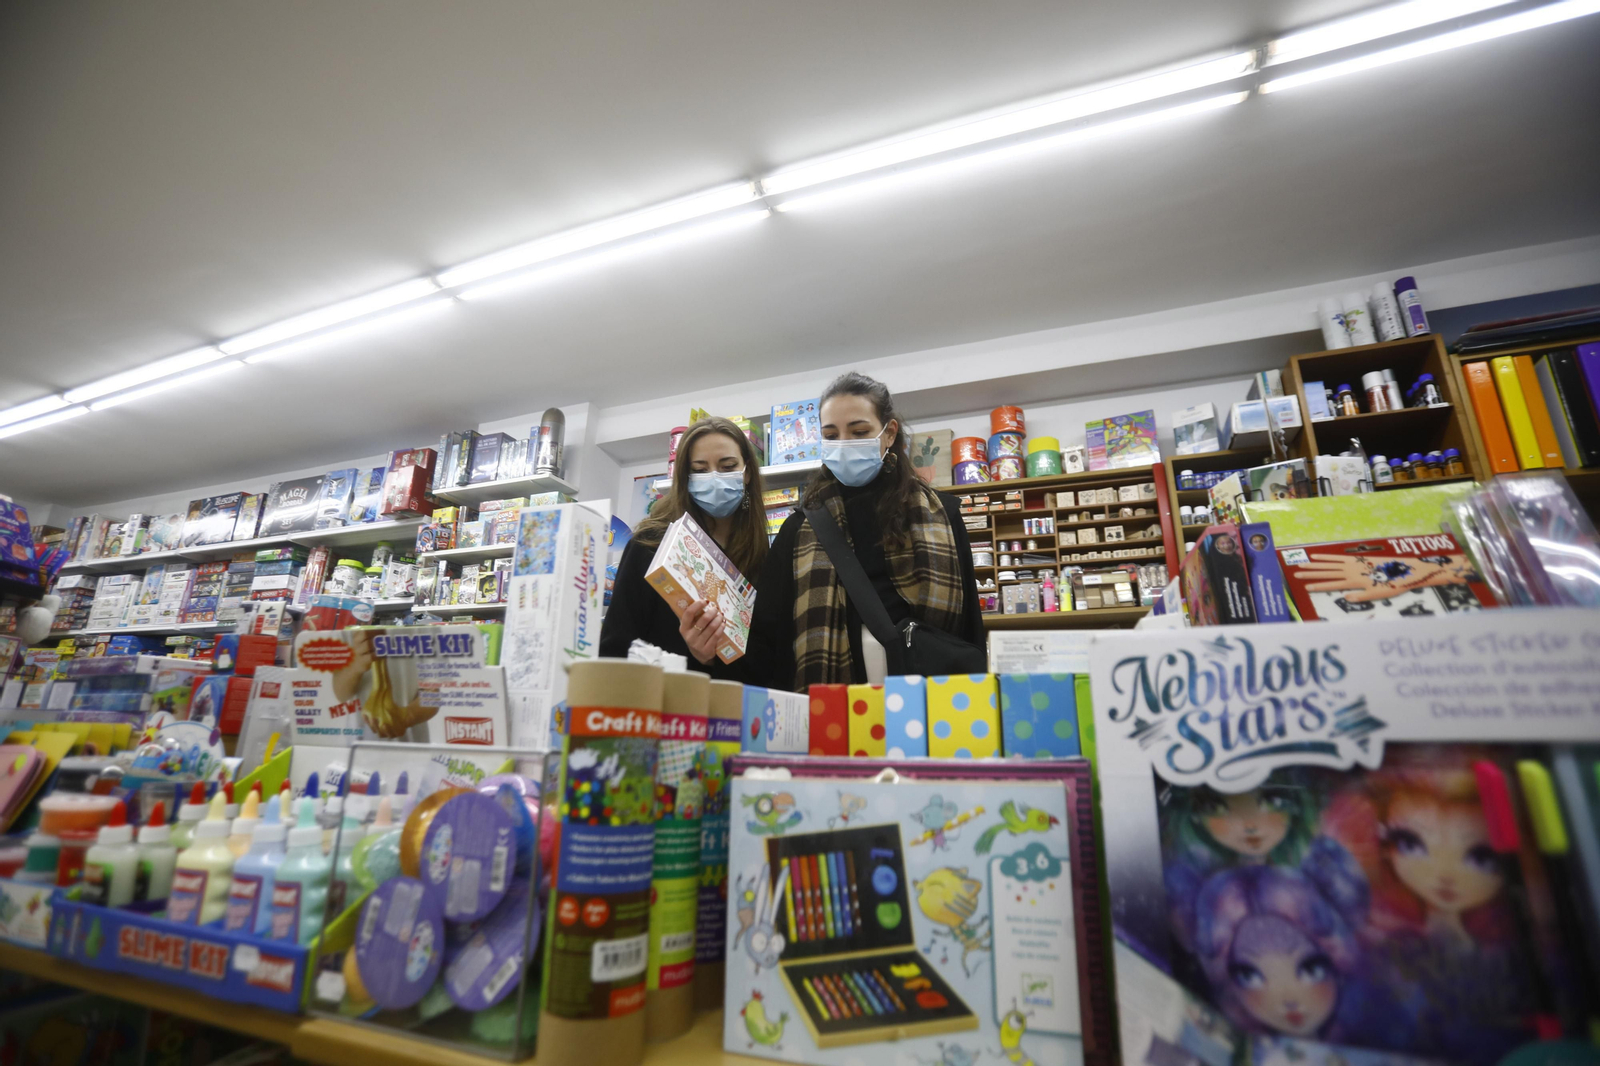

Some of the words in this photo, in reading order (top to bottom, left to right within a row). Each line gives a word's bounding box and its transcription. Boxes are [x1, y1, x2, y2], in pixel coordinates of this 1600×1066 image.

[279, 488, 309, 503] MAGIA
[1388, 535, 1454, 554] TATTOOS
[564, 546, 592, 658] Aquarellum
[374, 635, 432, 656] SLIME
[437, 634, 473, 656] KIT
[1109, 636, 1346, 722] Nebulous
[1384, 661, 1486, 678] Collection
[328, 698, 362, 719] NEW!
[1431, 702, 1505, 719] Deluxe
[446, 718, 493, 742] INSTANT
[586, 711, 642, 733] Craft
[1166, 690, 1330, 774] Stars
[119, 926, 184, 968] SLIME
[188, 938, 228, 980] KIT
